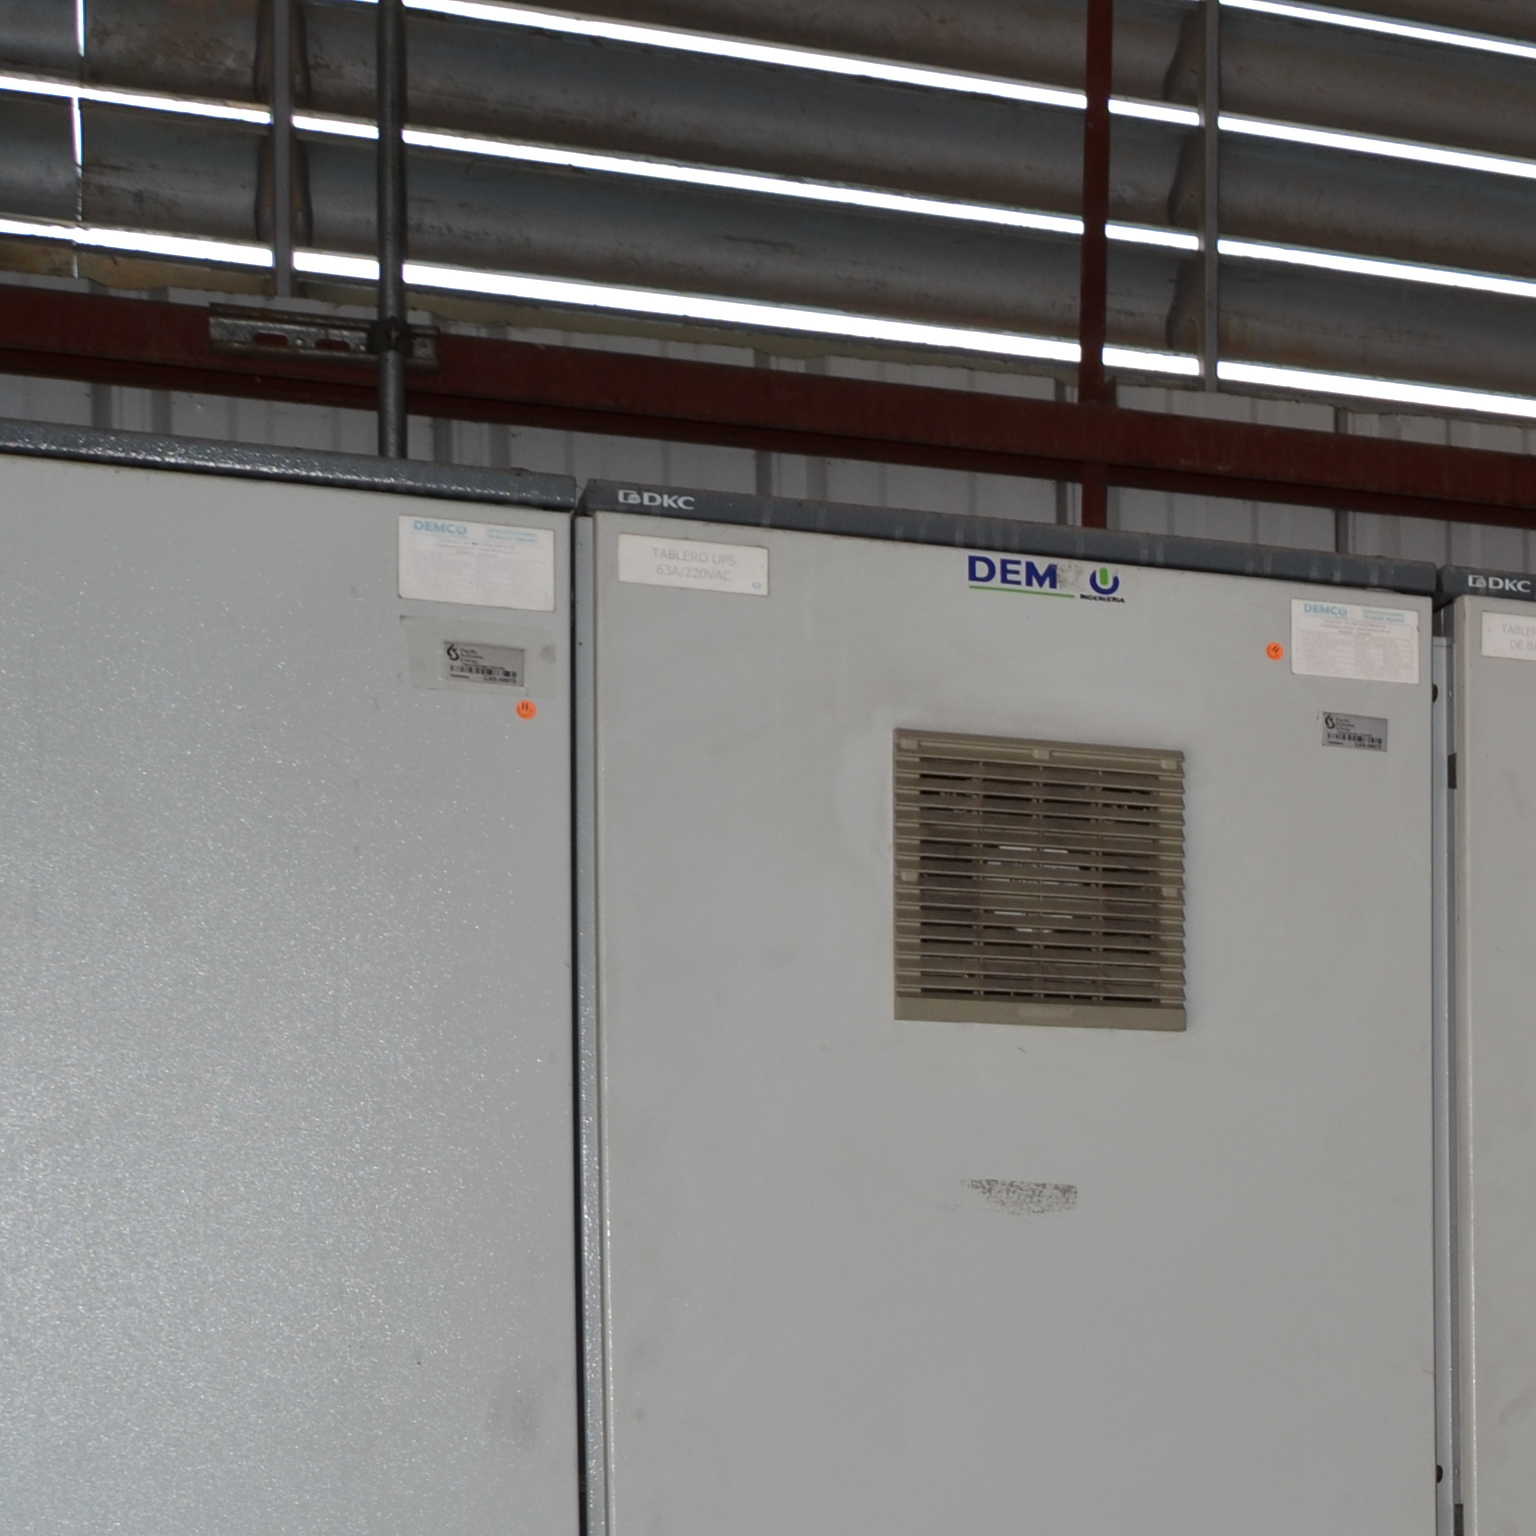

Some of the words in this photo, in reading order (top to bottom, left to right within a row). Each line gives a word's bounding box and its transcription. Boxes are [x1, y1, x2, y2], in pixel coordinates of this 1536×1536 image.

[651, 547, 708, 564] TABLERO
[712, 554, 736, 567] UPS
[657, 564, 731, 581] 63A/220VAC
[1510, 640, 1522, 650] DE
